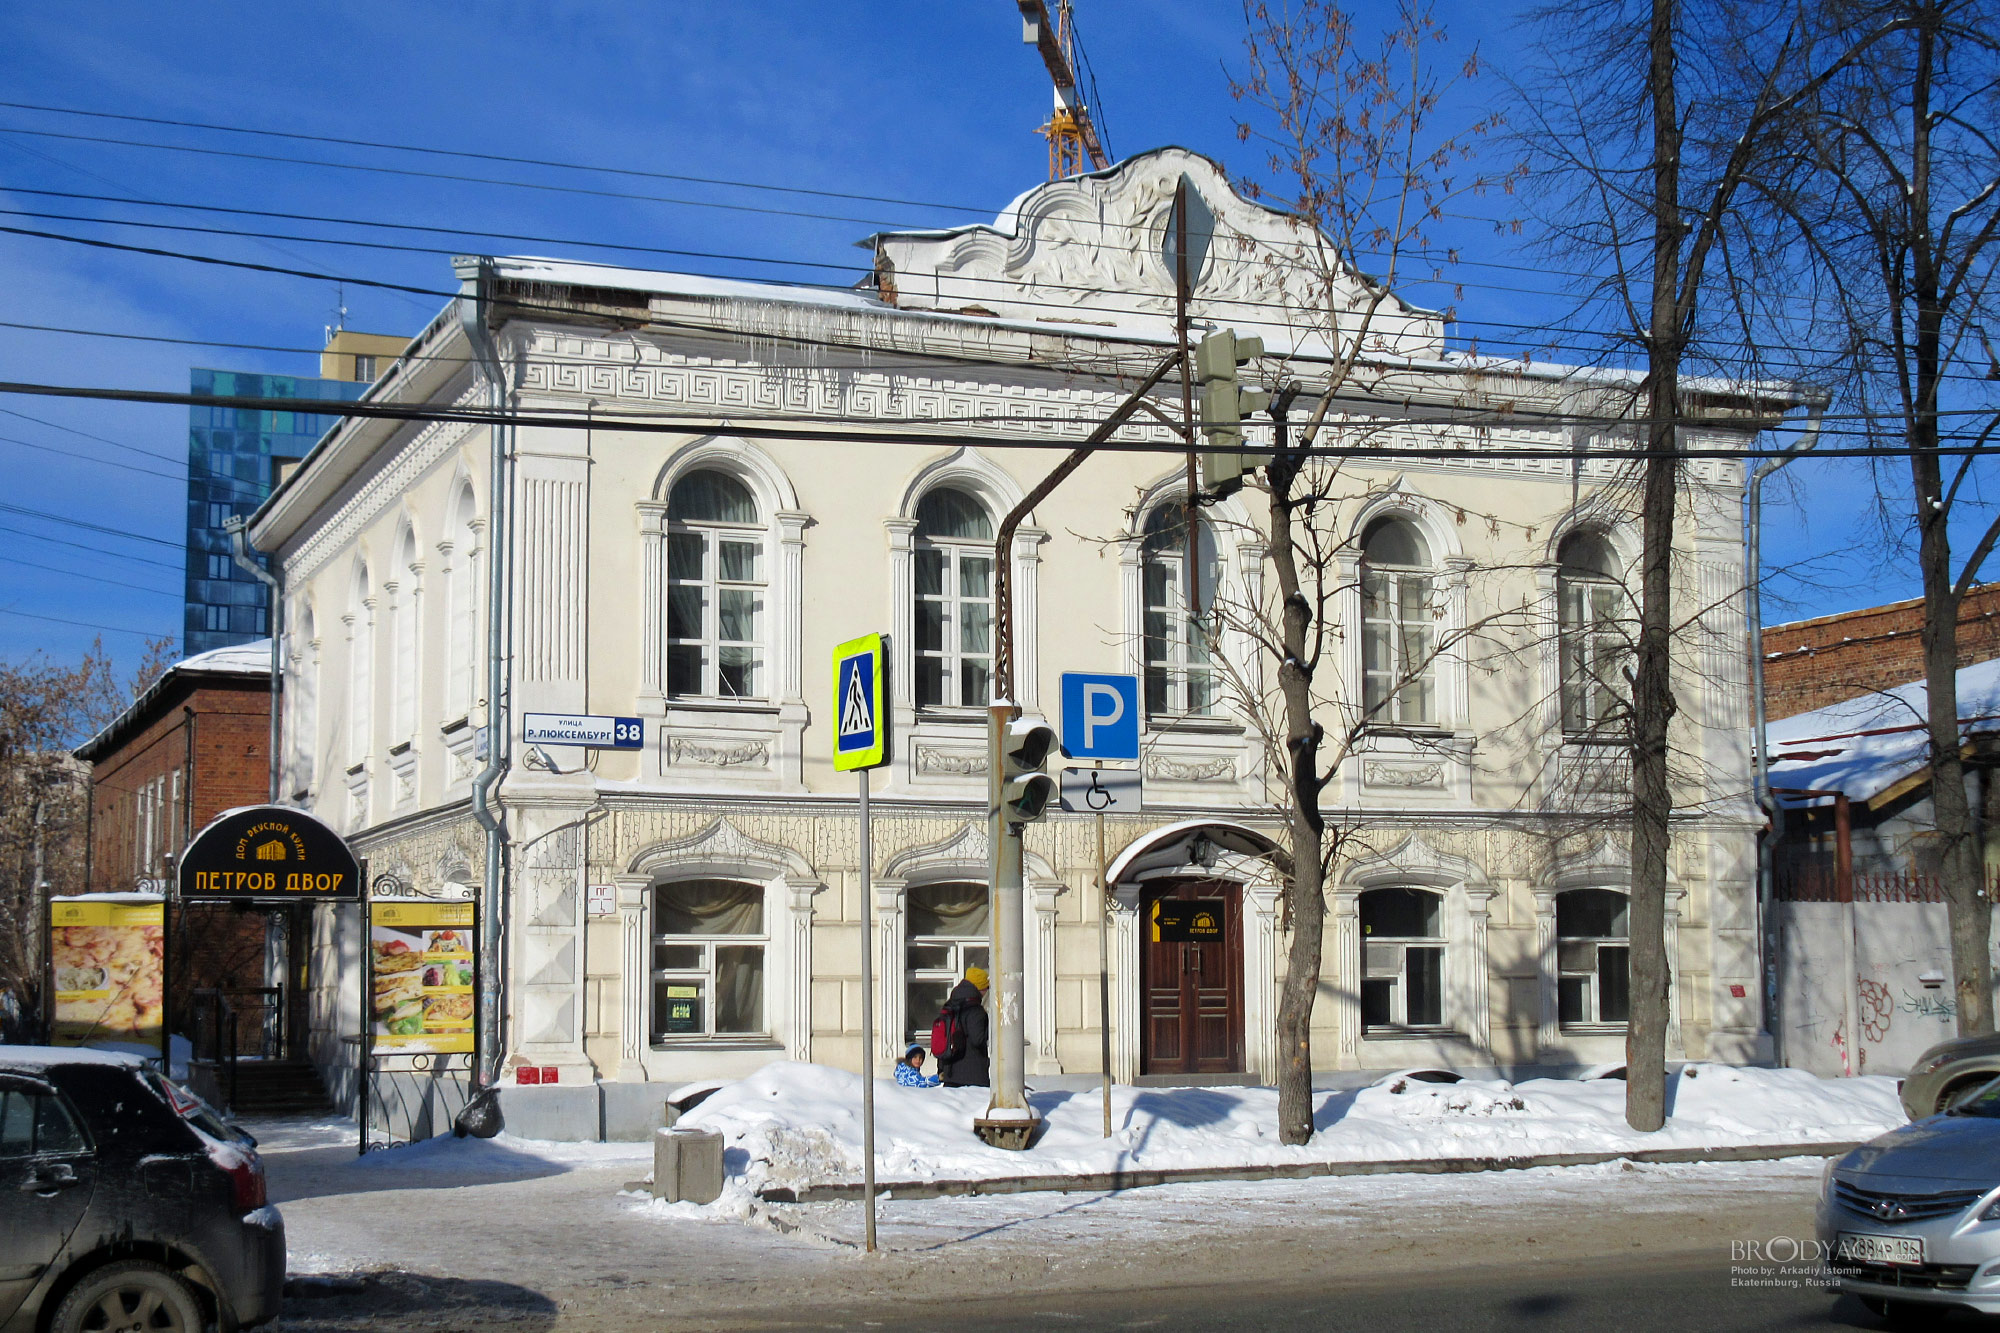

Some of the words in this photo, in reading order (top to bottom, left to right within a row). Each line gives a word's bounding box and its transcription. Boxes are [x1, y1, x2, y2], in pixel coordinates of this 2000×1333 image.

[1083, 682, 1124, 749] P
[527, 729, 537, 738] Р.
[538, 729, 612, 741] ЛЮКСЕМБУРГ
[616, 723, 641, 741] 38
[235, 837, 249, 860] ДОМ
[289, 831, 306, 861] КУХНИ
[195, 871, 277, 891] ПЕТРОВ
[285, 873, 344, 892] ДВОР
[596, 887, 608, 896] ПГ
